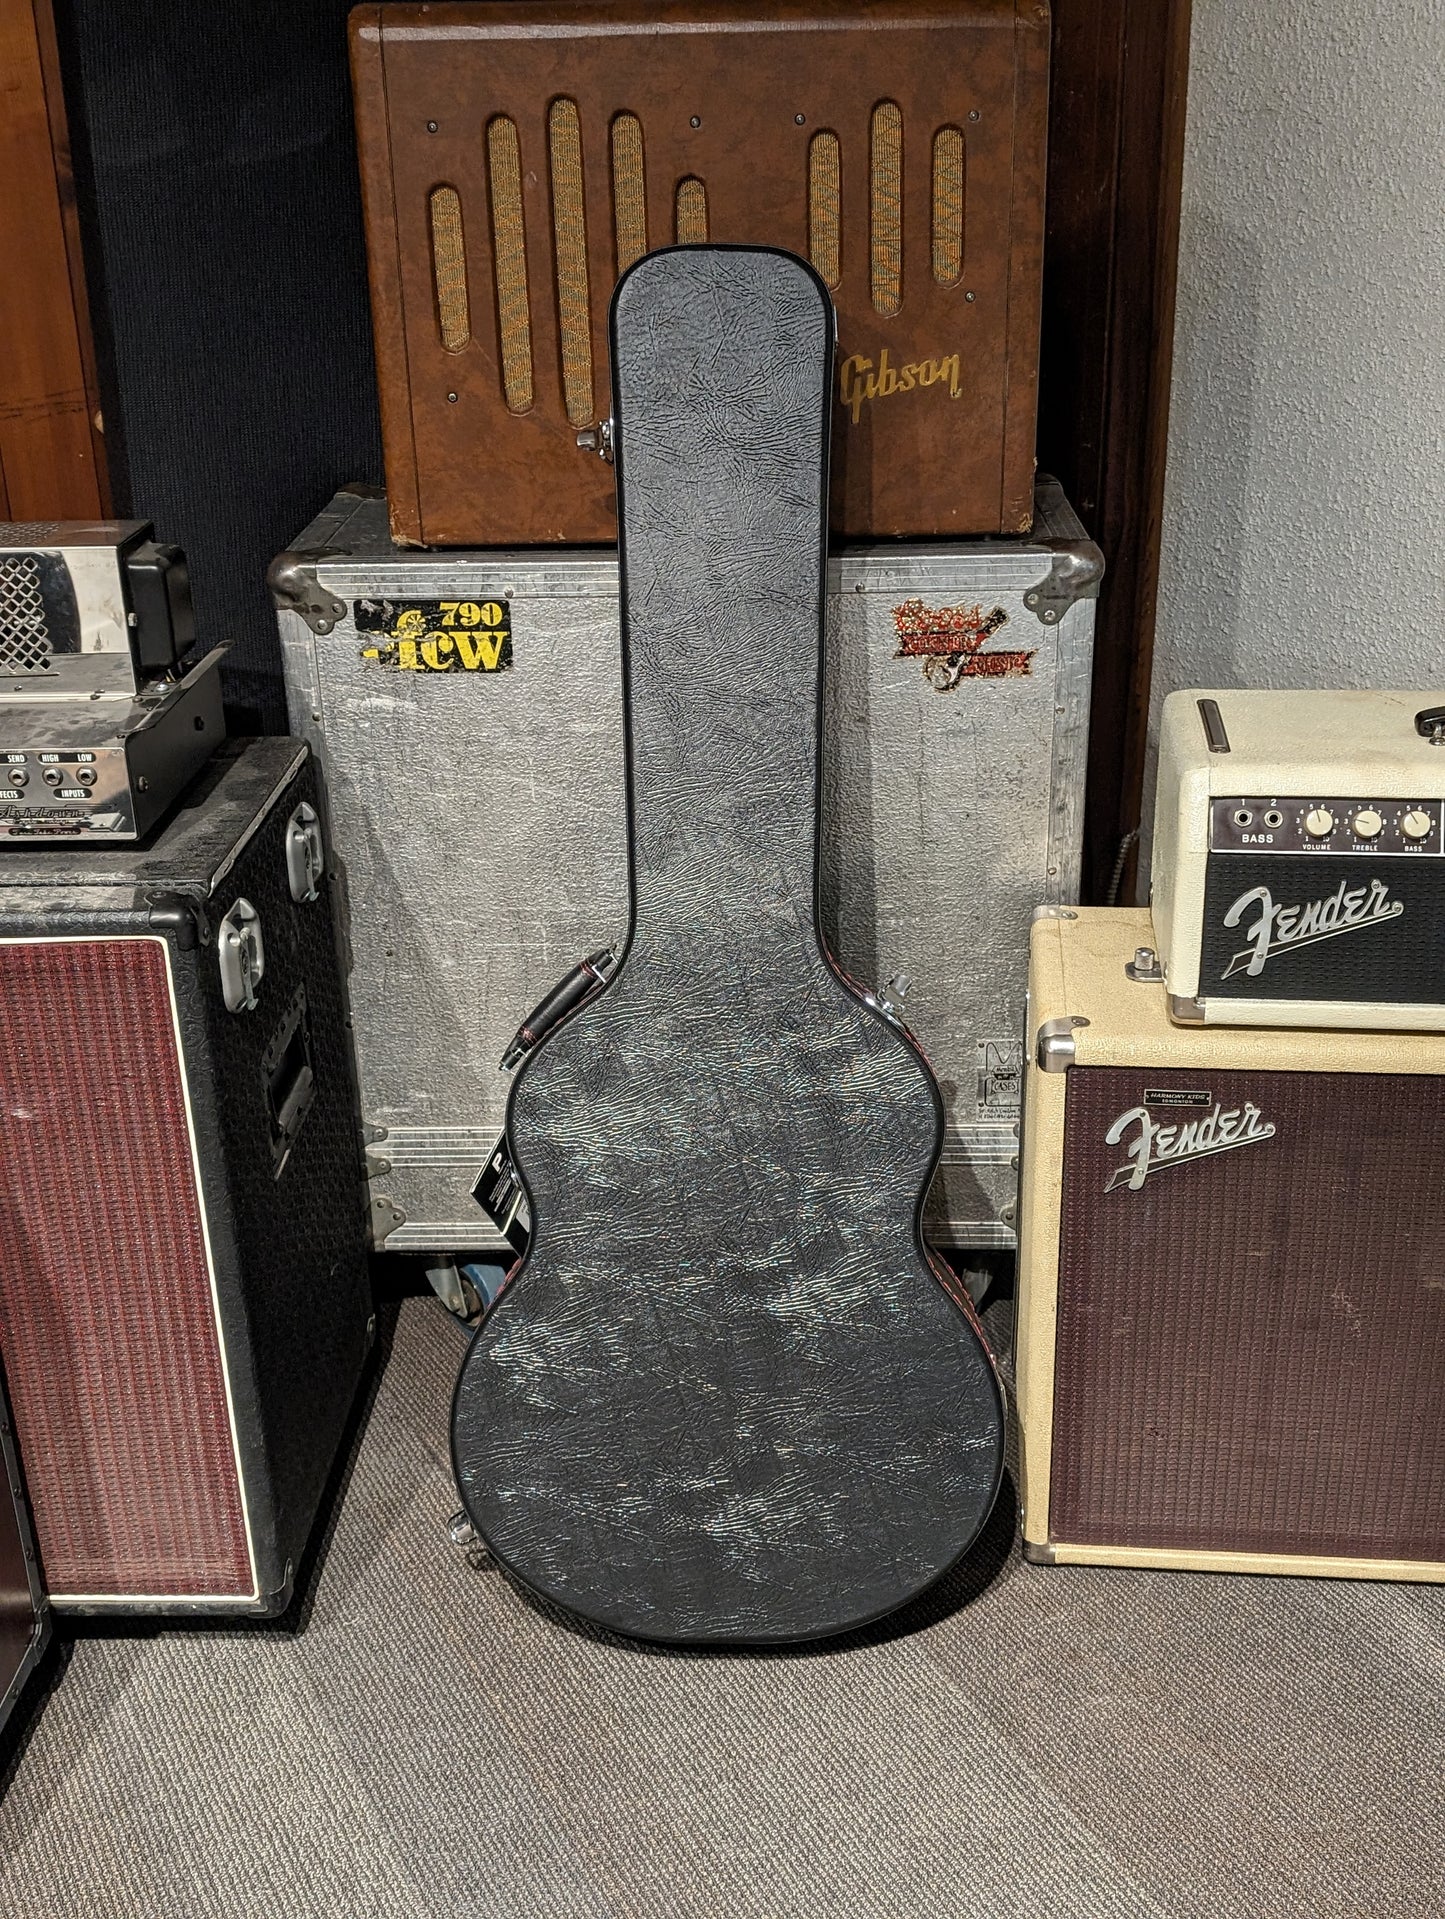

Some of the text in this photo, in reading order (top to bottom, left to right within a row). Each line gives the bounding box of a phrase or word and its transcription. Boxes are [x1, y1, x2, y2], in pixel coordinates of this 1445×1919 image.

[840, 348, 961, 424] Gibson
[439, 602, 502, 626] 790
[7, 755, 25, 763] SEND
[41, 754, 59, 762] HIGH
[61, 790, 85, 798] INPUTS
[1241, 834, 1274, 843] BASS
[1222, 879, 1404, 977] Fender
[1106, 1102, 1276, 1191] Fender
